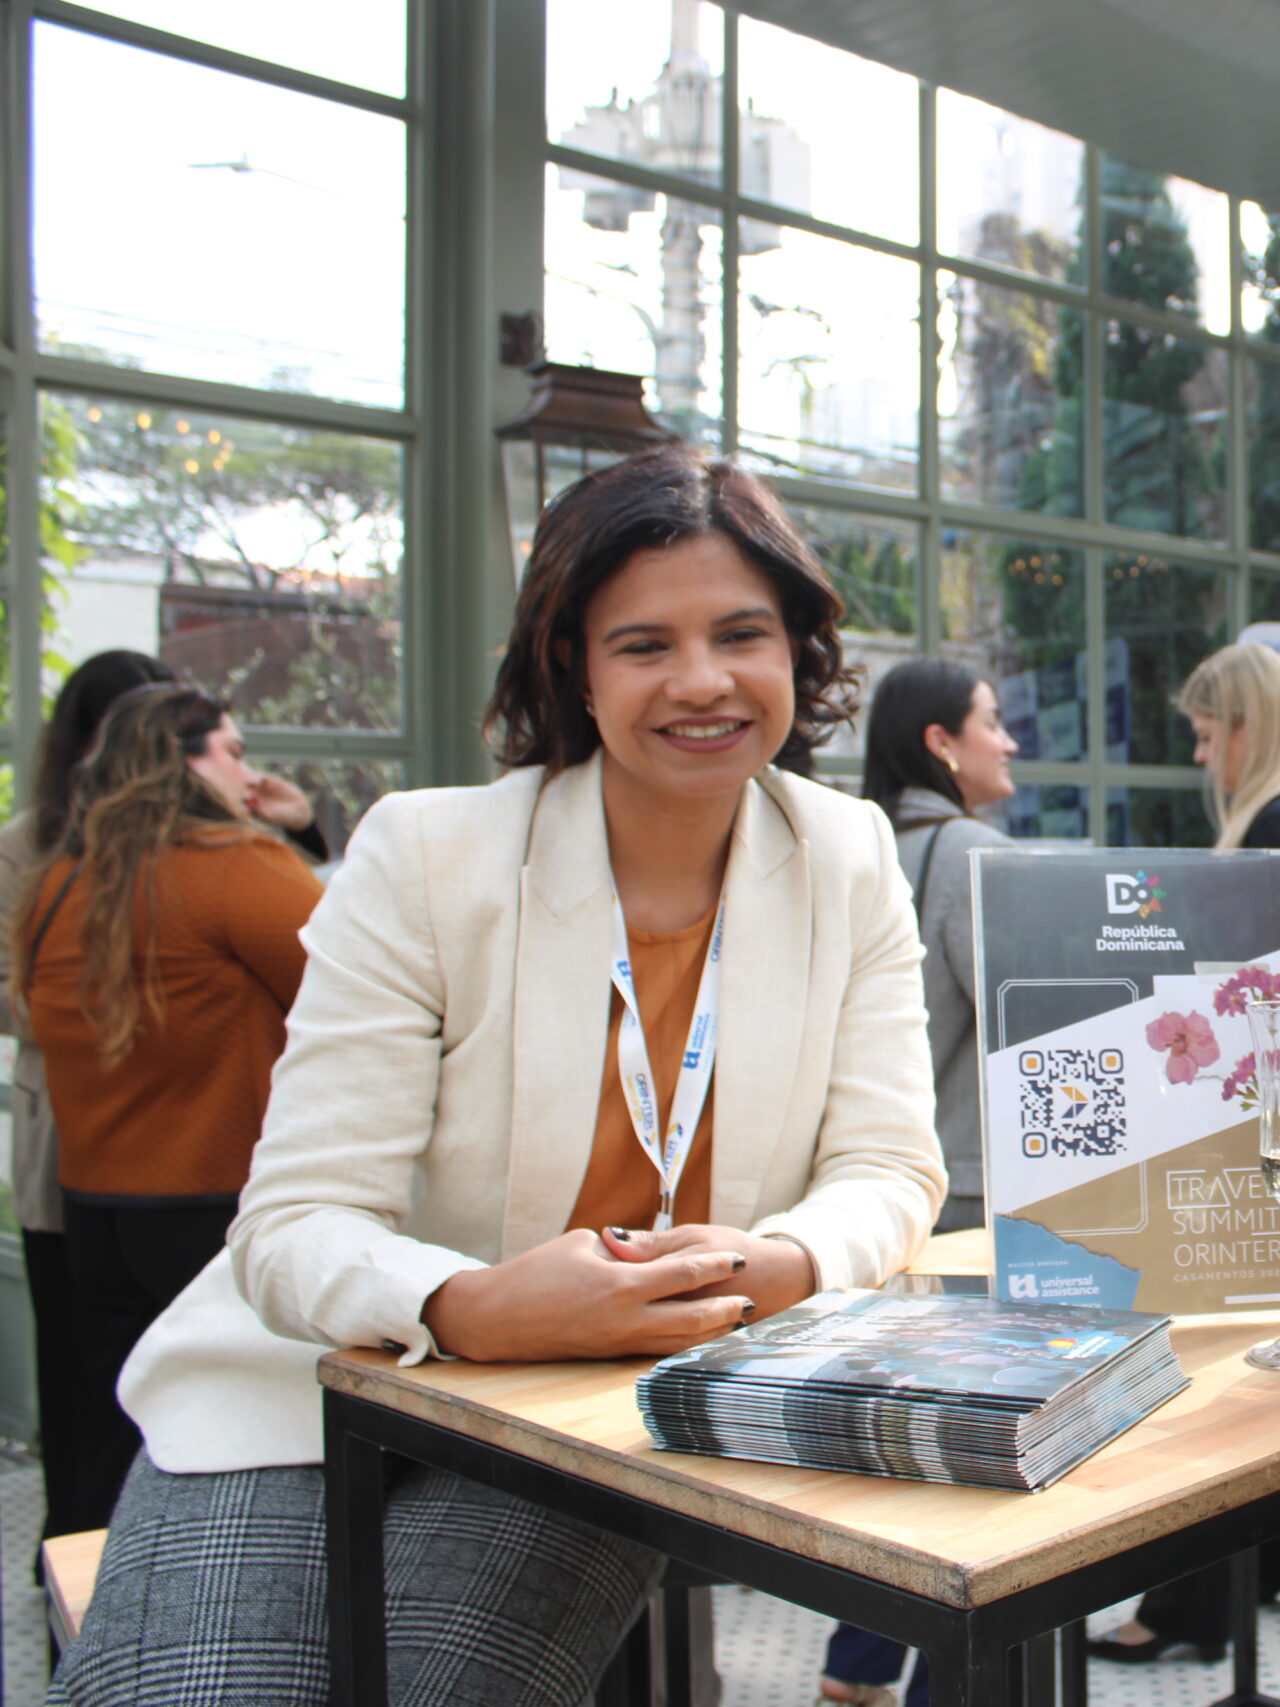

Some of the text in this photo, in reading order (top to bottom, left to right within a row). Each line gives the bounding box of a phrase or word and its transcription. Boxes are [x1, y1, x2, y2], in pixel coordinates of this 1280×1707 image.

[1102, 925, 1177, 940] República
[1096, 939, 1185, 951] Dominicana
[1173, 1207, 1280, 1235] SUMMIT
[1041, 1275, 1093, 1288] universal
[1173, 1271, 1255, 1282] CASAMENTOS
[1042, 1286, 1099, 1297] assistance
